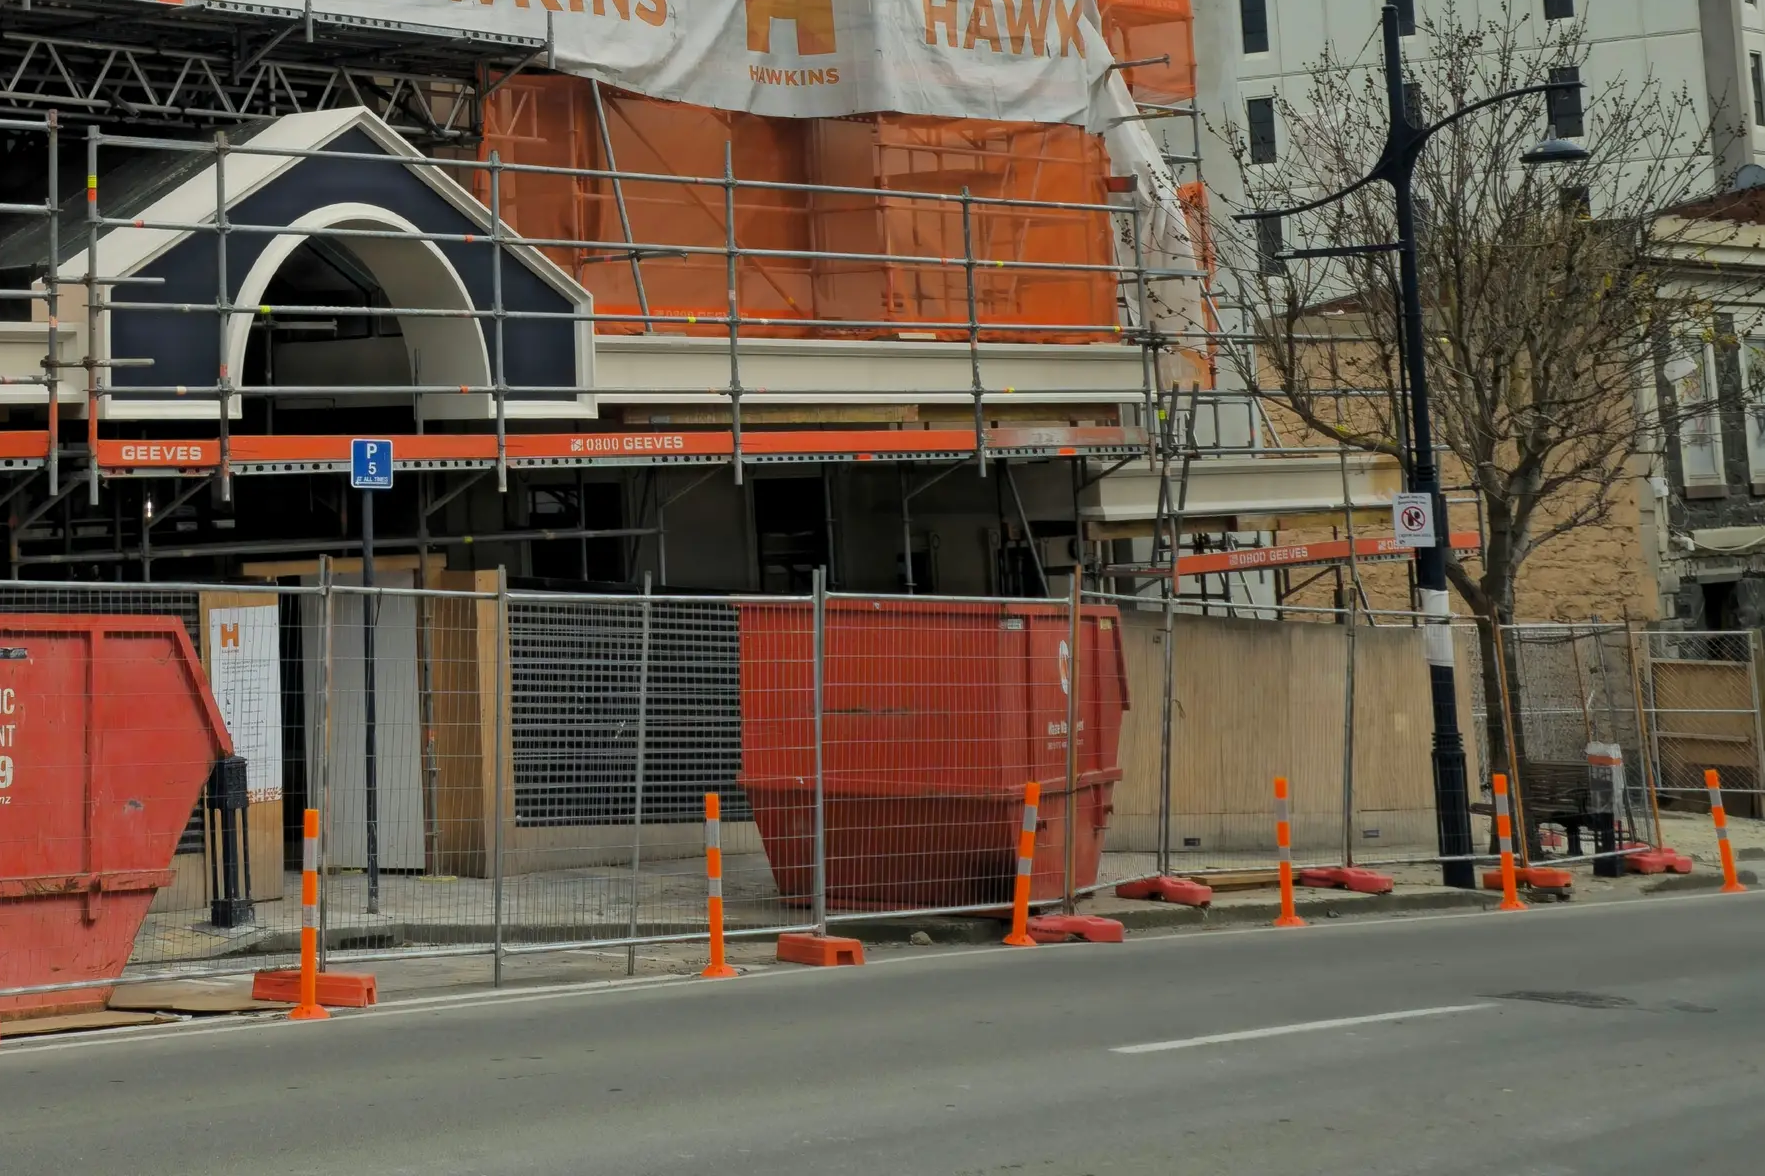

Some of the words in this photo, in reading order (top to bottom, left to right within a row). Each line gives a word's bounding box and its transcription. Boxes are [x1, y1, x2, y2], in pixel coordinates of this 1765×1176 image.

[747, 63, 841, 86] HAWKINS
[366, 442, 378, 459] P
[585, 437, 620, 451] 0800
[623, 435, 684, 451] GEEVES
[121, 445, 202, 461] GEEVES
[368, 461, 377, 475] 5
[1239, 551, 1267, 565] 0800
[1269, 546, 1309, 562] GEEVES
[220, 623, 240, 648] H
